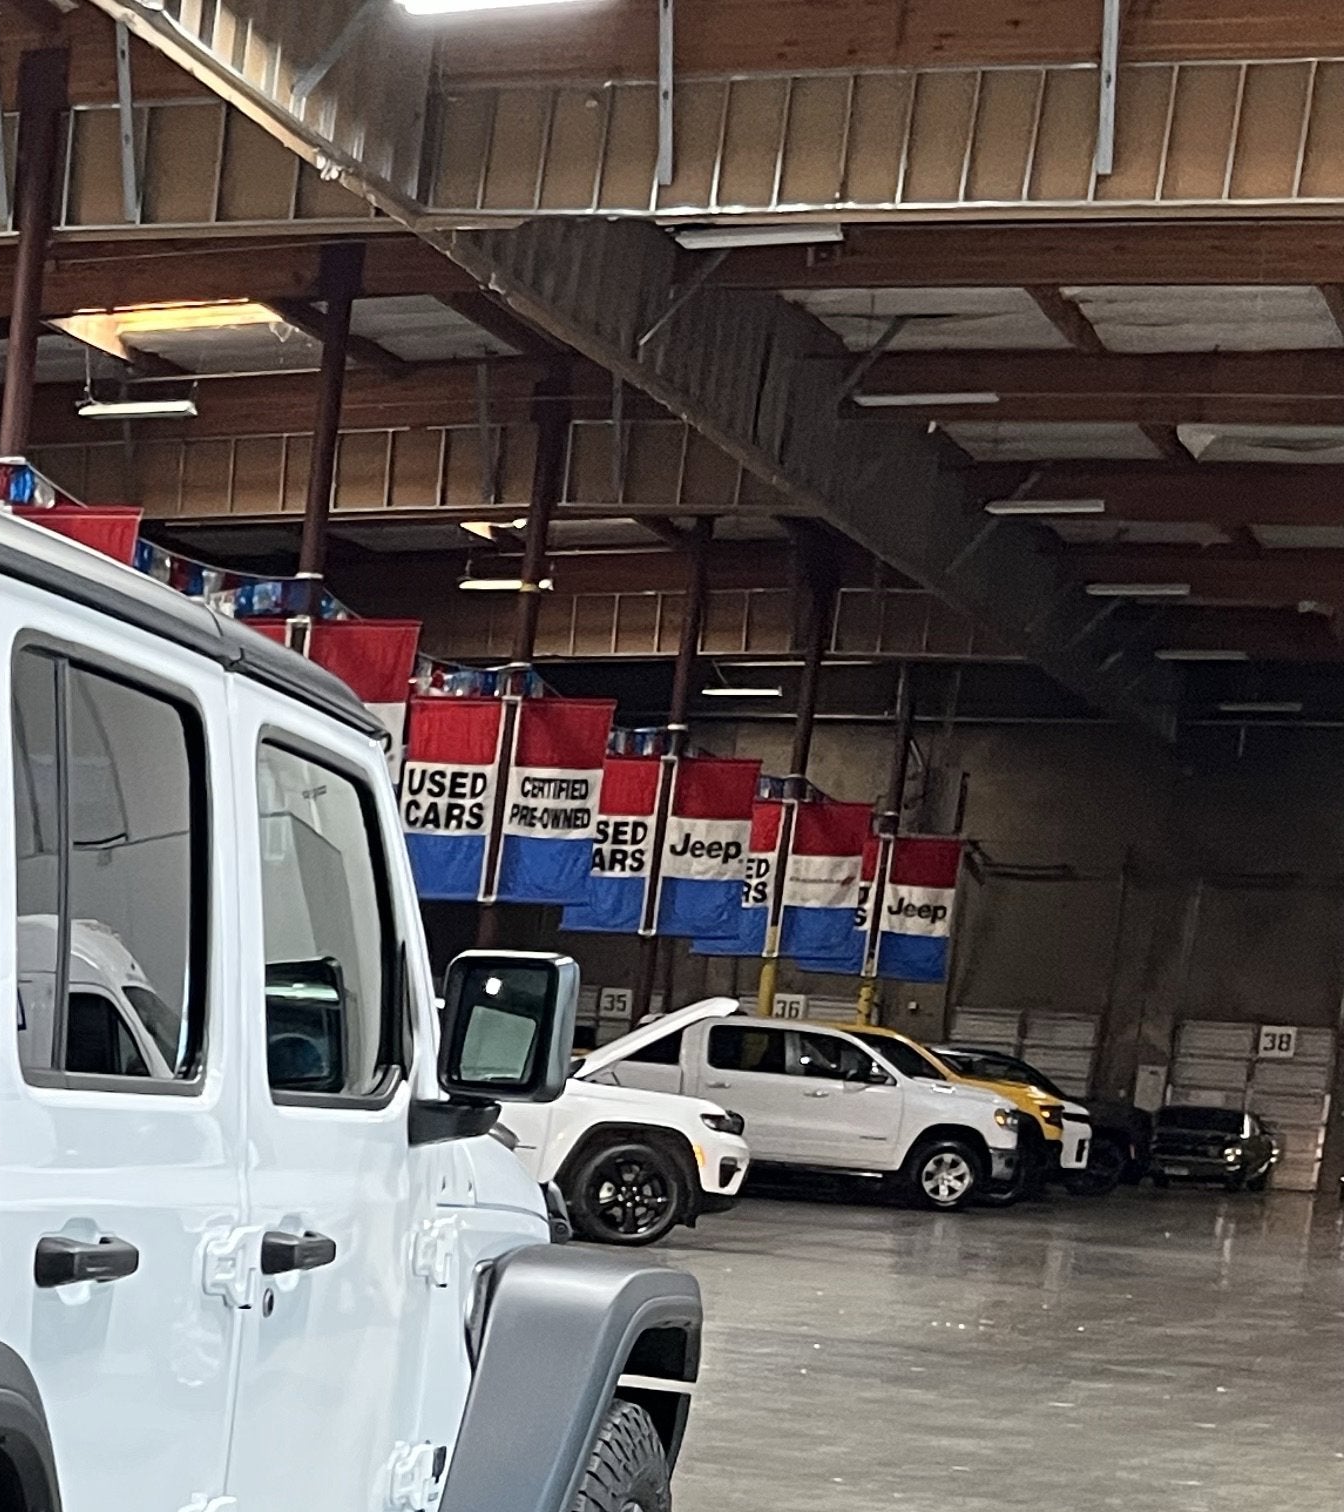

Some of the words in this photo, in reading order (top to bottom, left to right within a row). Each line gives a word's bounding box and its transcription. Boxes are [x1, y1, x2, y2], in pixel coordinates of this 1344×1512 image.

[408, 768, 488, 800] USED
[520, 776, 589, 801] CERTIFIED
[404, 799, 485, 830] CARS
[508, 803, 592, 830] PRE-OWNED
[595, 820, 649, 846] SED
[591, 847, 645, 873] ARS
[669, 832, 742, 865] Jeep
[745, 858, 771, 879] ED
[887, 896, 947, 924] Jeep
[602, 993, 627, 1012] 35
[774, 1000, 801, 1019] 36
[1262, 1032, 1293, 1052] 38
